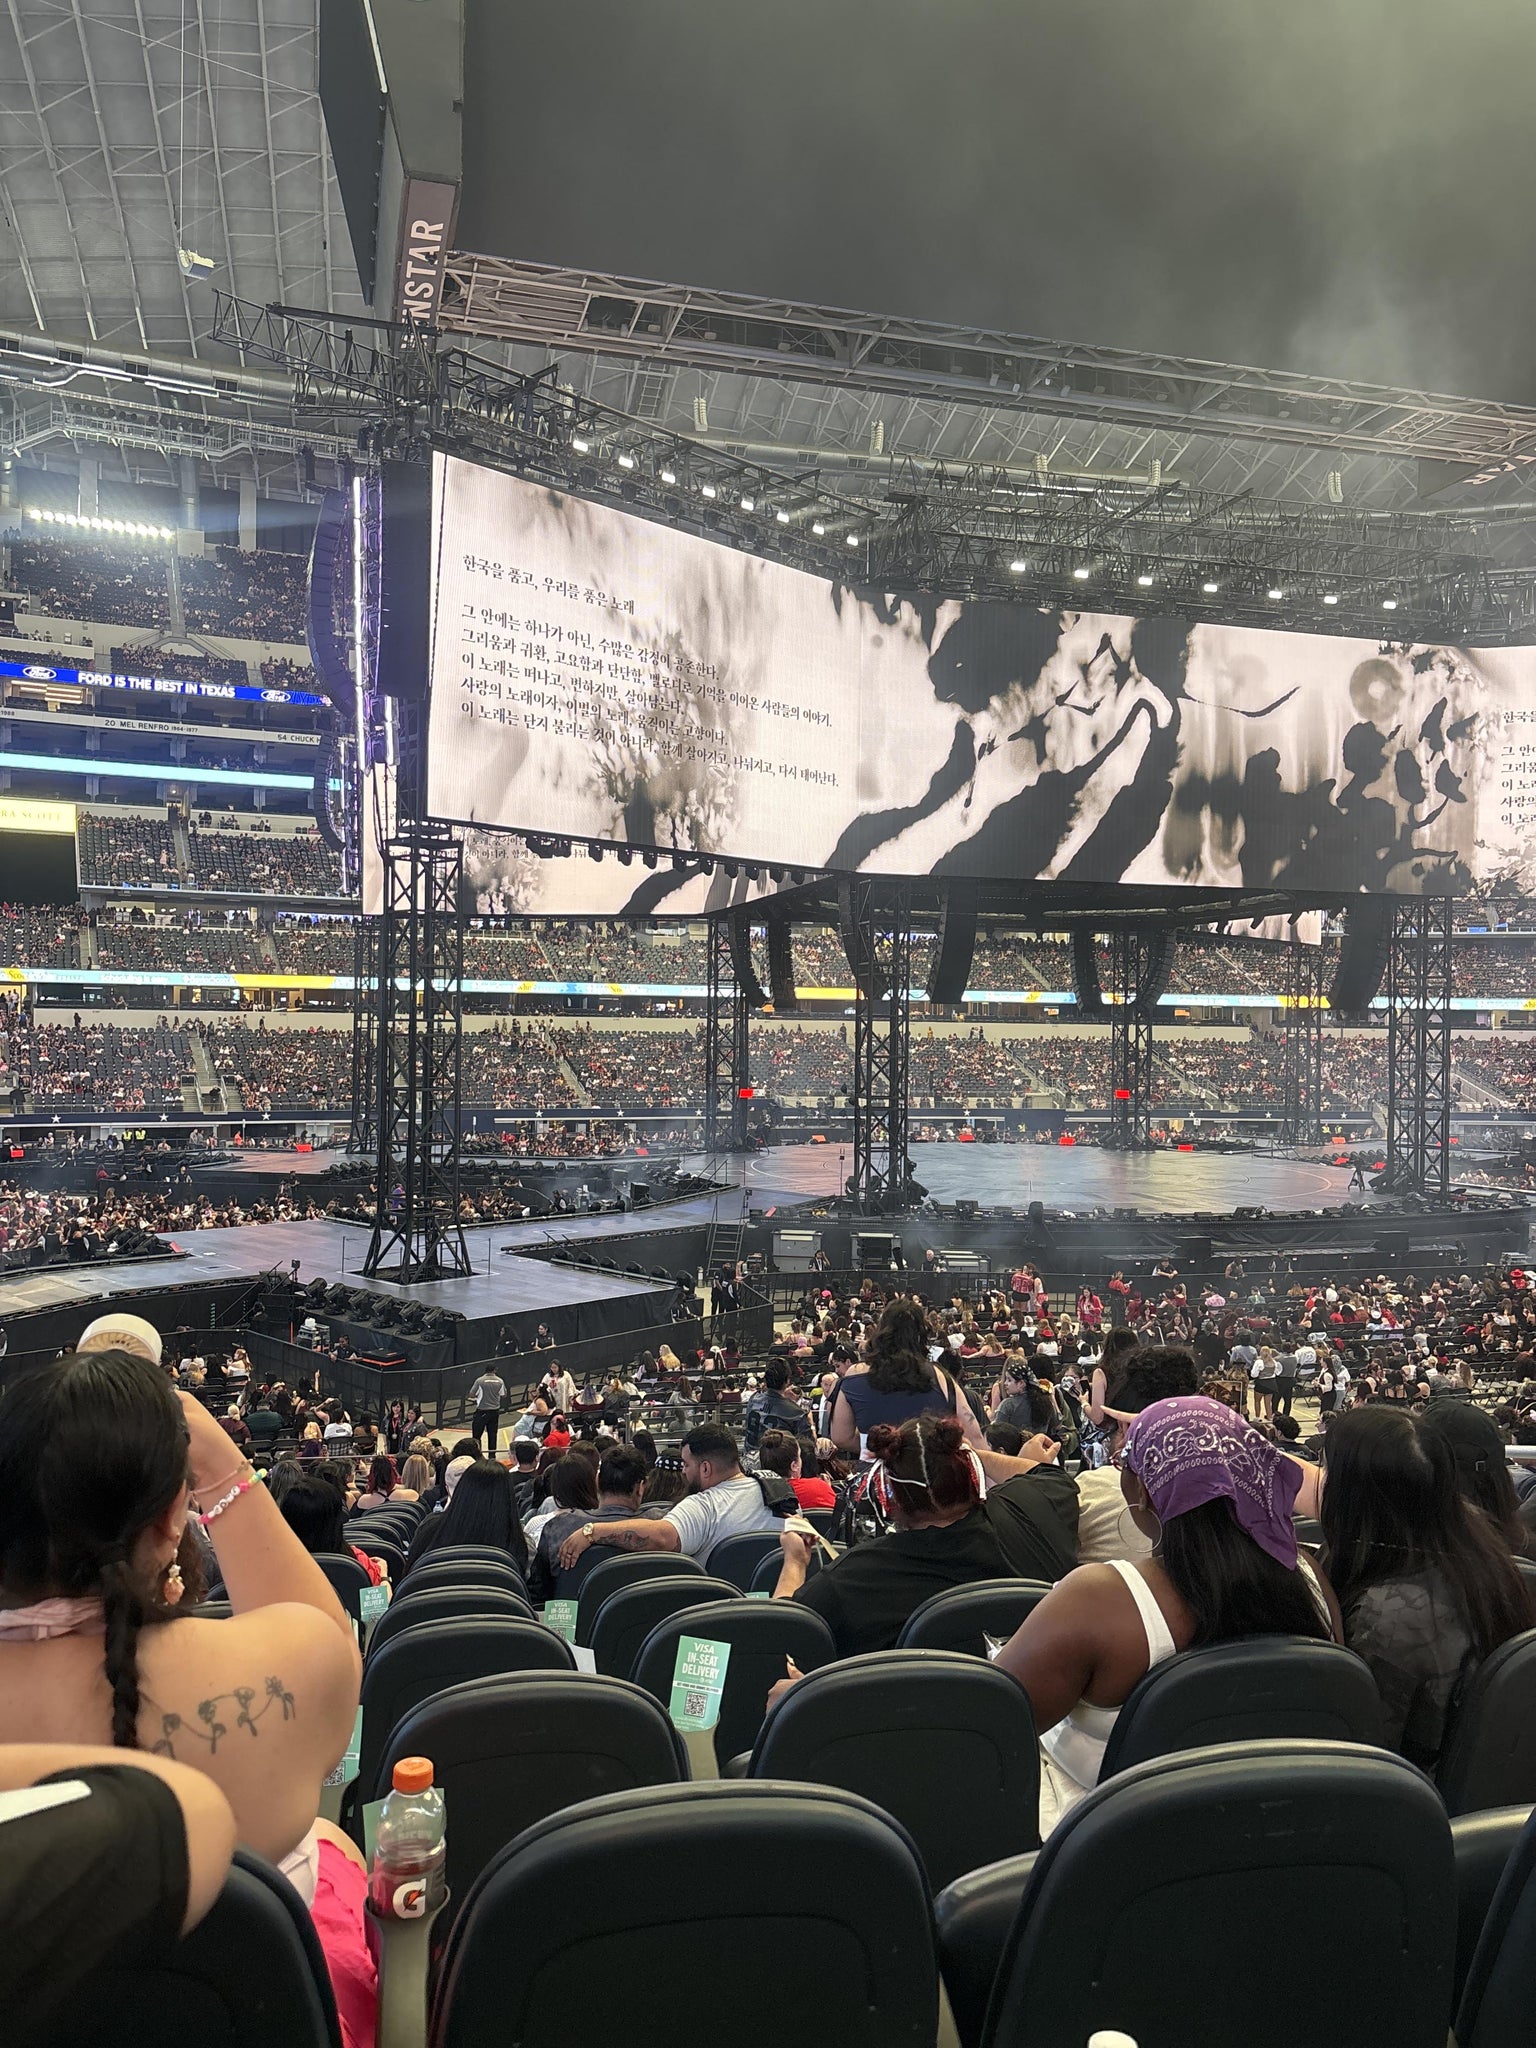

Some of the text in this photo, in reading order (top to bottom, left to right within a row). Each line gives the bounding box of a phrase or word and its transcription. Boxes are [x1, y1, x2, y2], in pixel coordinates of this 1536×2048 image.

[462, 554, 635, 615] 한국을 품고, 우리를 품은 노래
[461, 604, 720, 681] 그 안에는 하나가 아닌, 수많은 감정이 공존한다.
[78, 672, 236, 698] FORD IS THE BEST IN TEXAS
[461, 628, 832, 728] 그리움과 귀환, 고요함과 단단함, 멜로디로 기억을 이어온 사람들의 이야기.
[462, 652, 684, 715] 이 노래는 떠나고, 변하지만, 살아남는다.
[460, 676, 728, 746] 사랑의 노래이자, 이별의 노래, 움직이는 고향이다.
[104, 719, 116, 727] 20
[119, 720, 136, 728] MEL
[138, 722, 170, 731] RENFRO
[290, 735, 315, 743] CHUCK
[461, 700, 474, 718] 이
[478, 705, 520, 726] 노래는
[523, 713, 548, 732] 단지
[552, 718, 590, 740] 불리는
[593, 727, 616, 745] 것이
[620, 733, 657, 754] 아니라,
[660, 740, 683, 758] 함께
[686, 746, 731, 769] 살아지고,
[778, 764, 797, 780] 다시
[800, 768, 839, 788] 태어난다.
[1501, 746, 1515, 757] 그
[1501, 778, 1513, 791] 이
[1501, 812, 1512, 825] 이
[687, 1651, 719, 1667] IN-SEAT
[694, 1642, 715, 1654] VISA
[682, 1662, 720, 1680] DELIVERY
[392, 1878, 427, 1919] G
